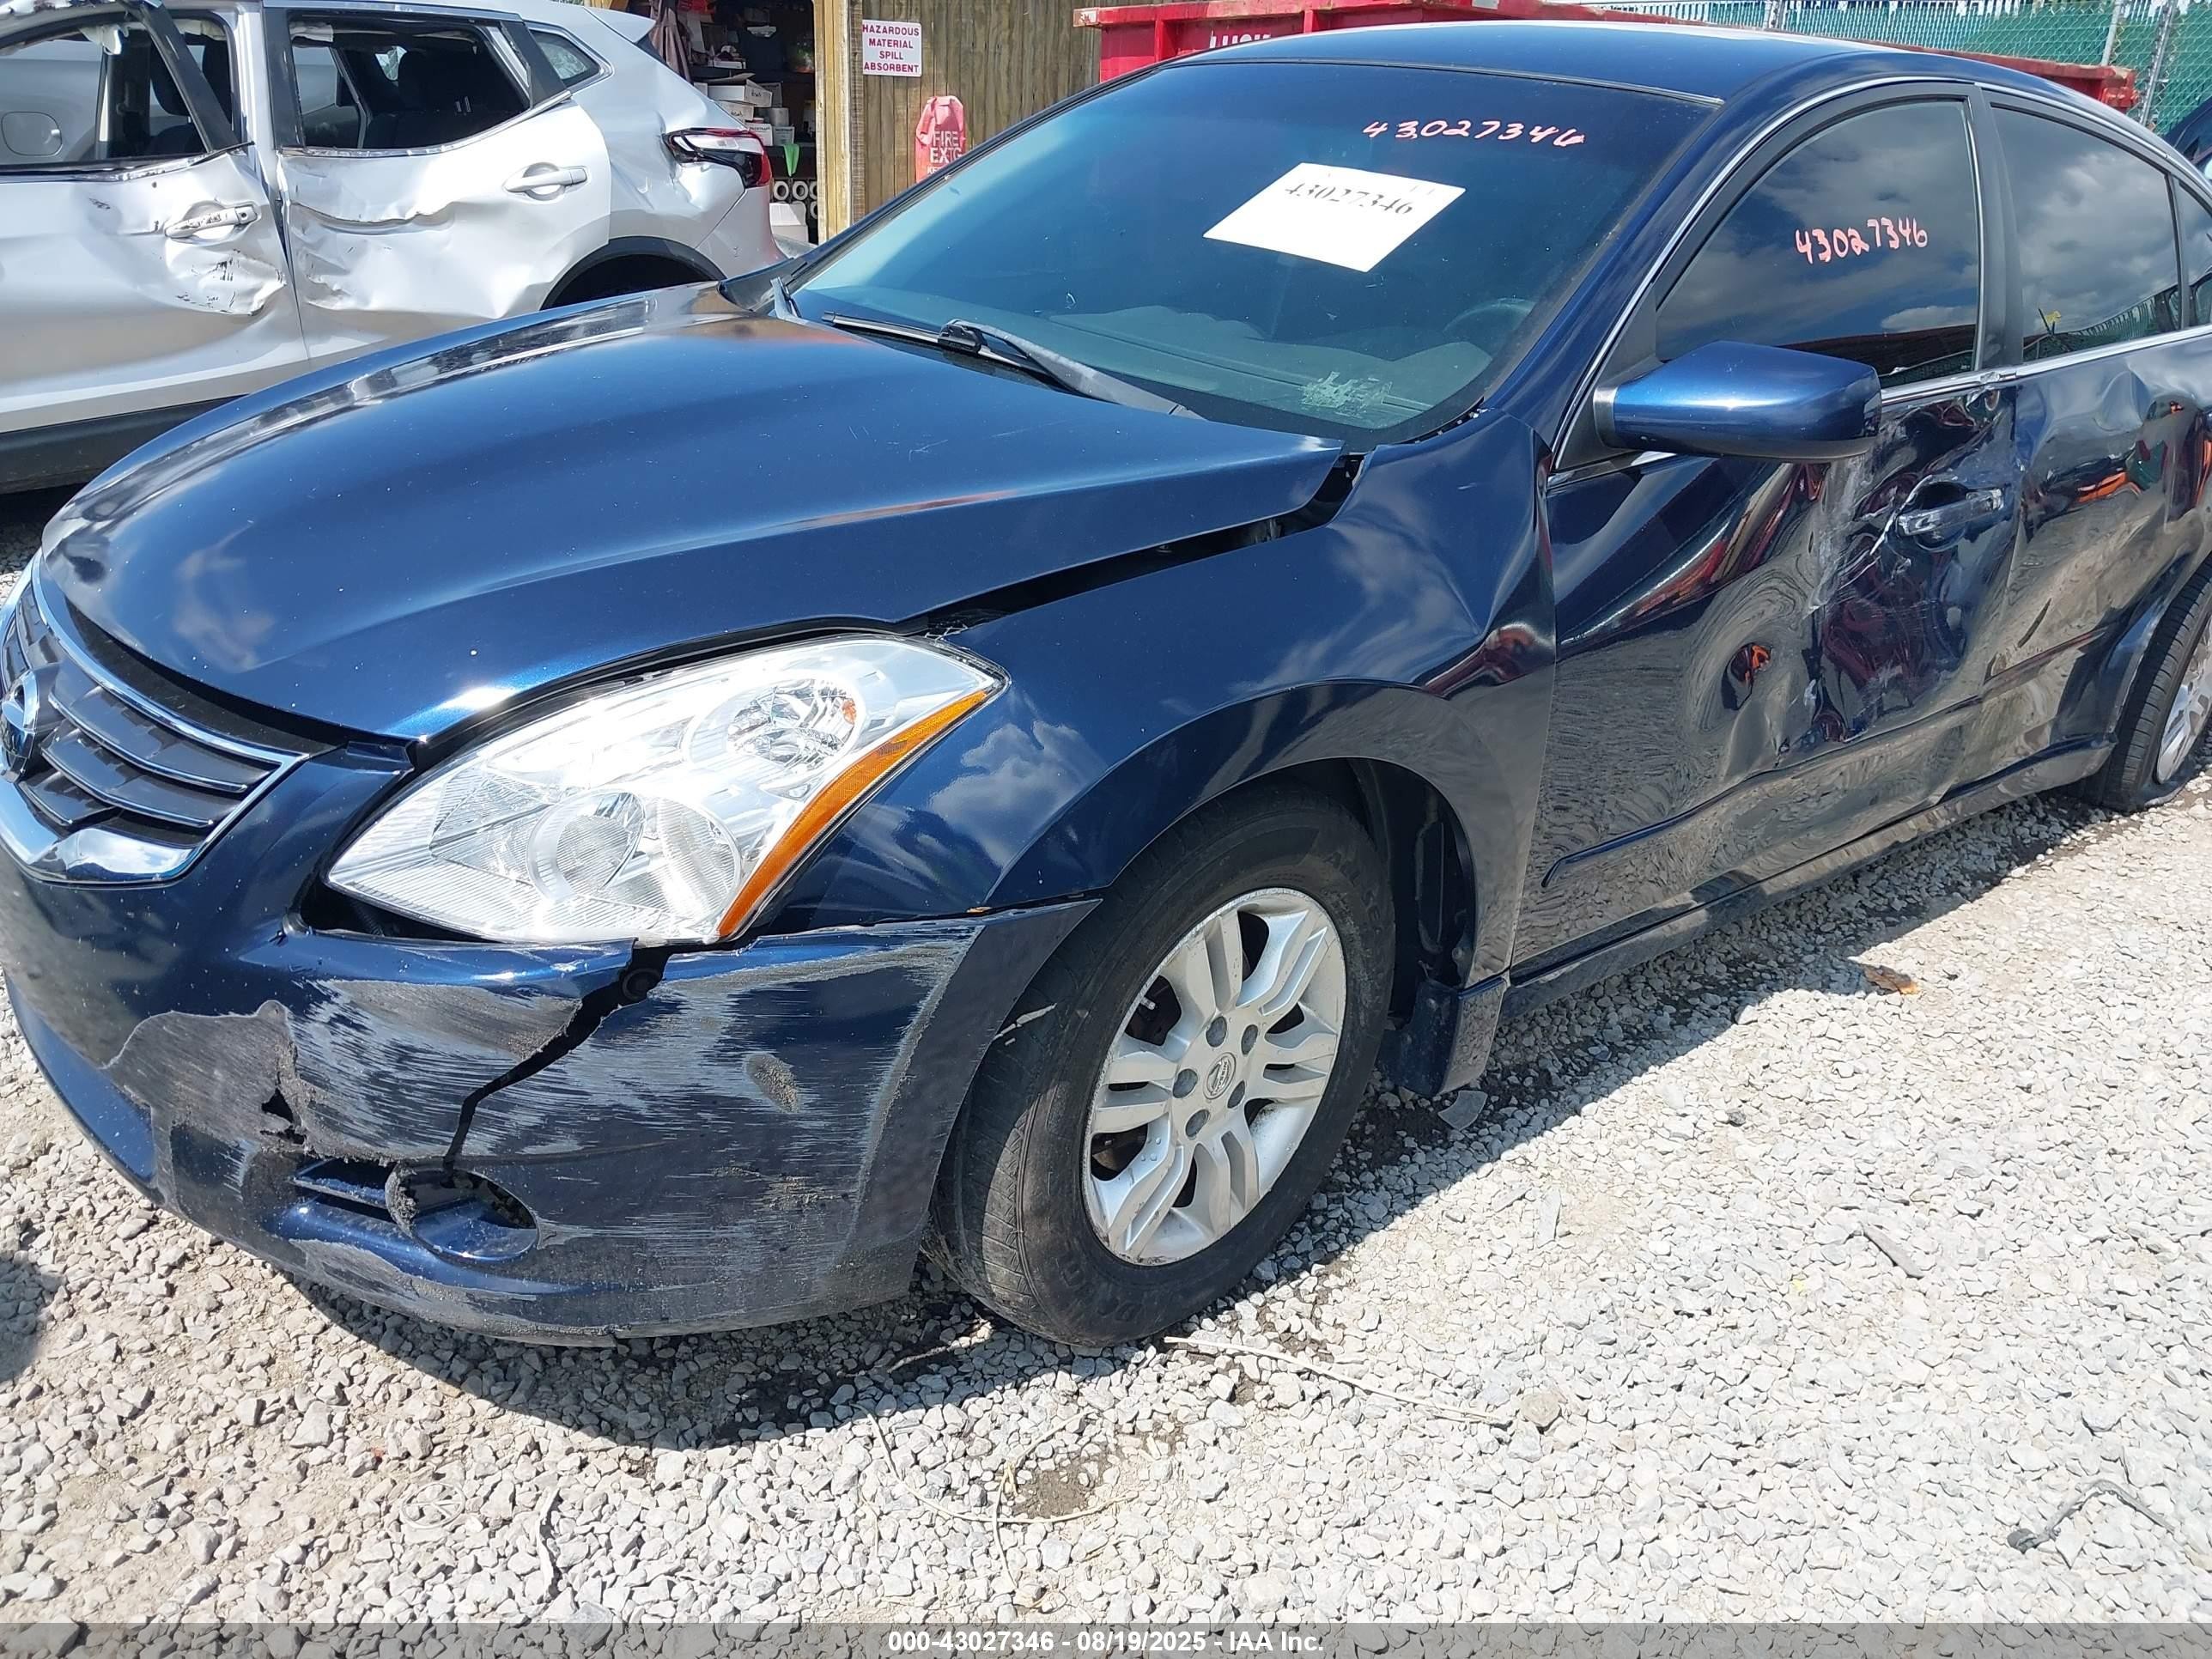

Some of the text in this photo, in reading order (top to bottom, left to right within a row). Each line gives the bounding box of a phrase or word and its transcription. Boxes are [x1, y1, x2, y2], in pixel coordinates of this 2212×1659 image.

[862, 24, 920, 36] HAZARDOUS
[868, 38, 914, 49] MATERIAL
[878, 50, 904, 60] SPILL
[864, 62, 920, 73] ABSORBENT
[933, 131, 959, 147] FIRE
[1363, 120, 1585, 147] 43027346
[1284, 182, 1413, 215] 43027346
[1795, 216, 1928, 264] 43027346
